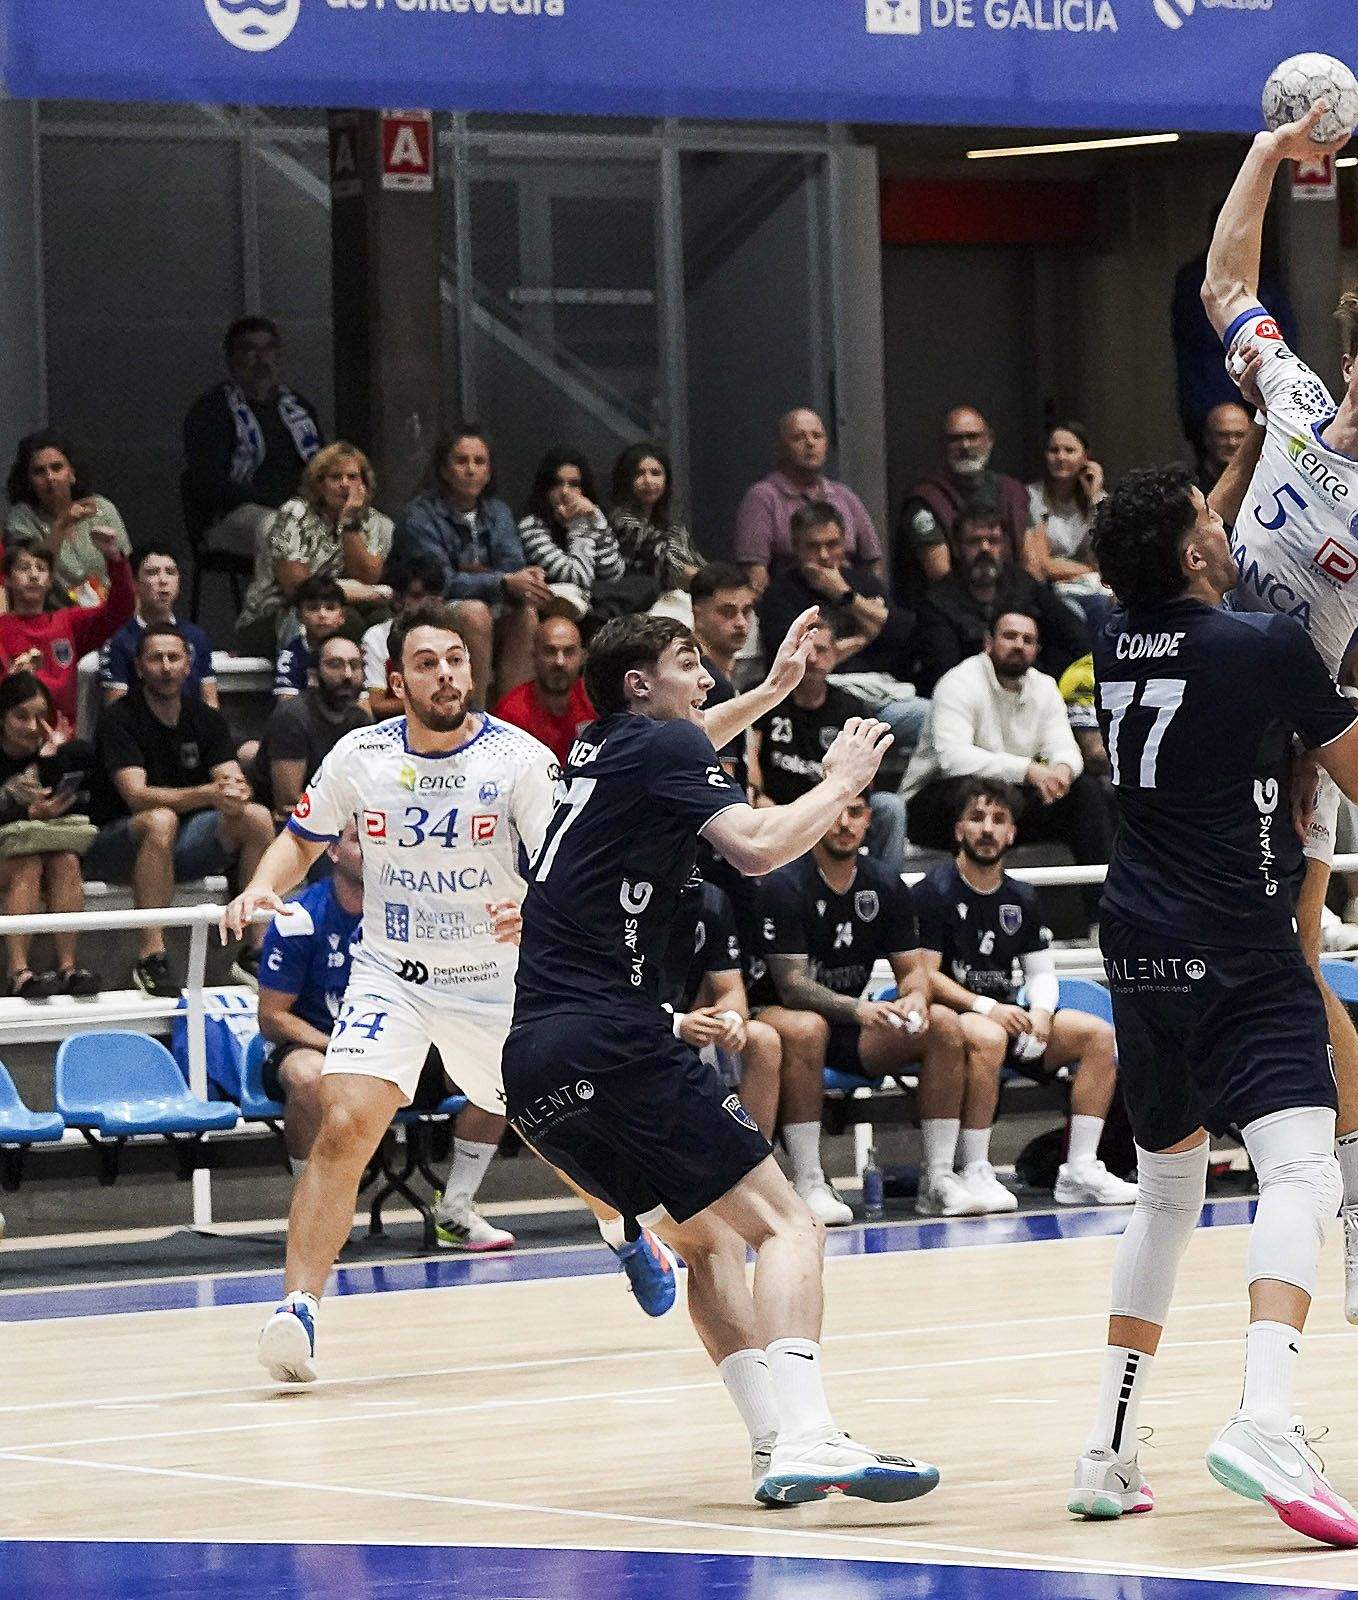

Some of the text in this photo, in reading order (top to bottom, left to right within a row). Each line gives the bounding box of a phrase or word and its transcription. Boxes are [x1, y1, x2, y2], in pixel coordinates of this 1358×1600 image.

[930, 0, 1118, 32] DE GALICIA
[390, 126, 424, 167] A
[1301, 453, 1349, 502] ence
[1253, 482, 1309, 531] 5
[1231, 527, 1312, 633] ANCA
[1116, 632, 1186, 660] CONDE
[1099, 679, 1187, 788] 77
[419, 775, 467, 790] ence
[398, 806, 459, 848] 34
[1259, 815, 1279, 896] GITRANS
[433, 961, 498, 976] Deputación
